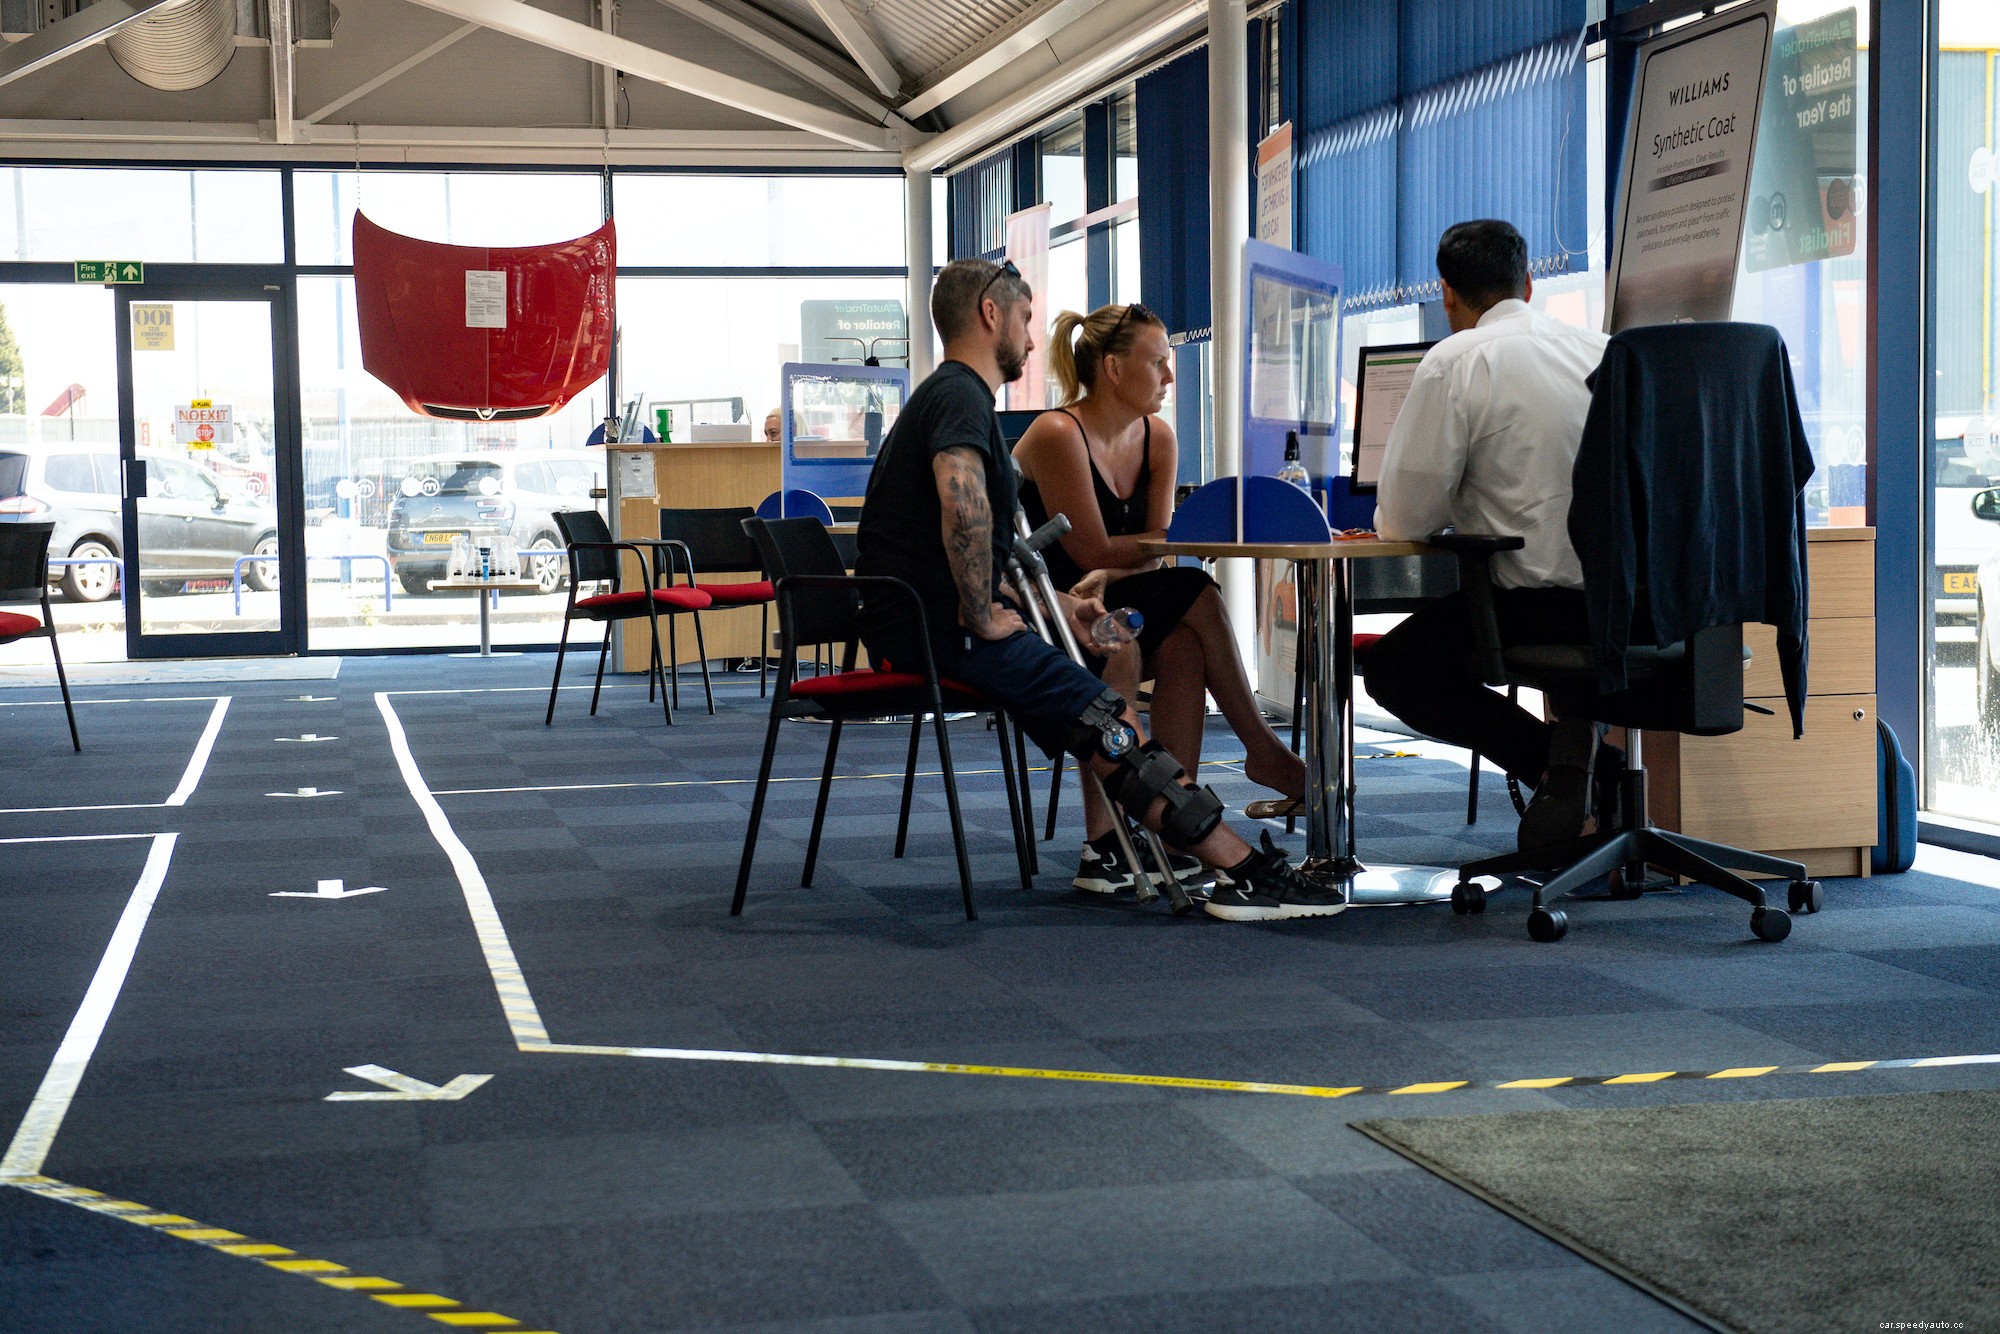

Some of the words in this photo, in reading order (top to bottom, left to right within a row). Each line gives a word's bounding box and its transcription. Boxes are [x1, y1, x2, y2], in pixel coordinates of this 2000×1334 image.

[1669, 72, 1730, 107] WILLIAMS
[1652, 121, 1705, 158] Synthetic
[1707, 112, 1737, 139] Coat
[1671, 203, 1688, 217] product
[1688, 197, 1711, 212] designed
[1717, 193, 1735, 205] protect
[1659, 222, 1678, 236] bumpers
[1715, 207, 1731, 219] traffic
[1671, 232, 1691, 246] everyday
[80, 264, 96, 272] Fire
